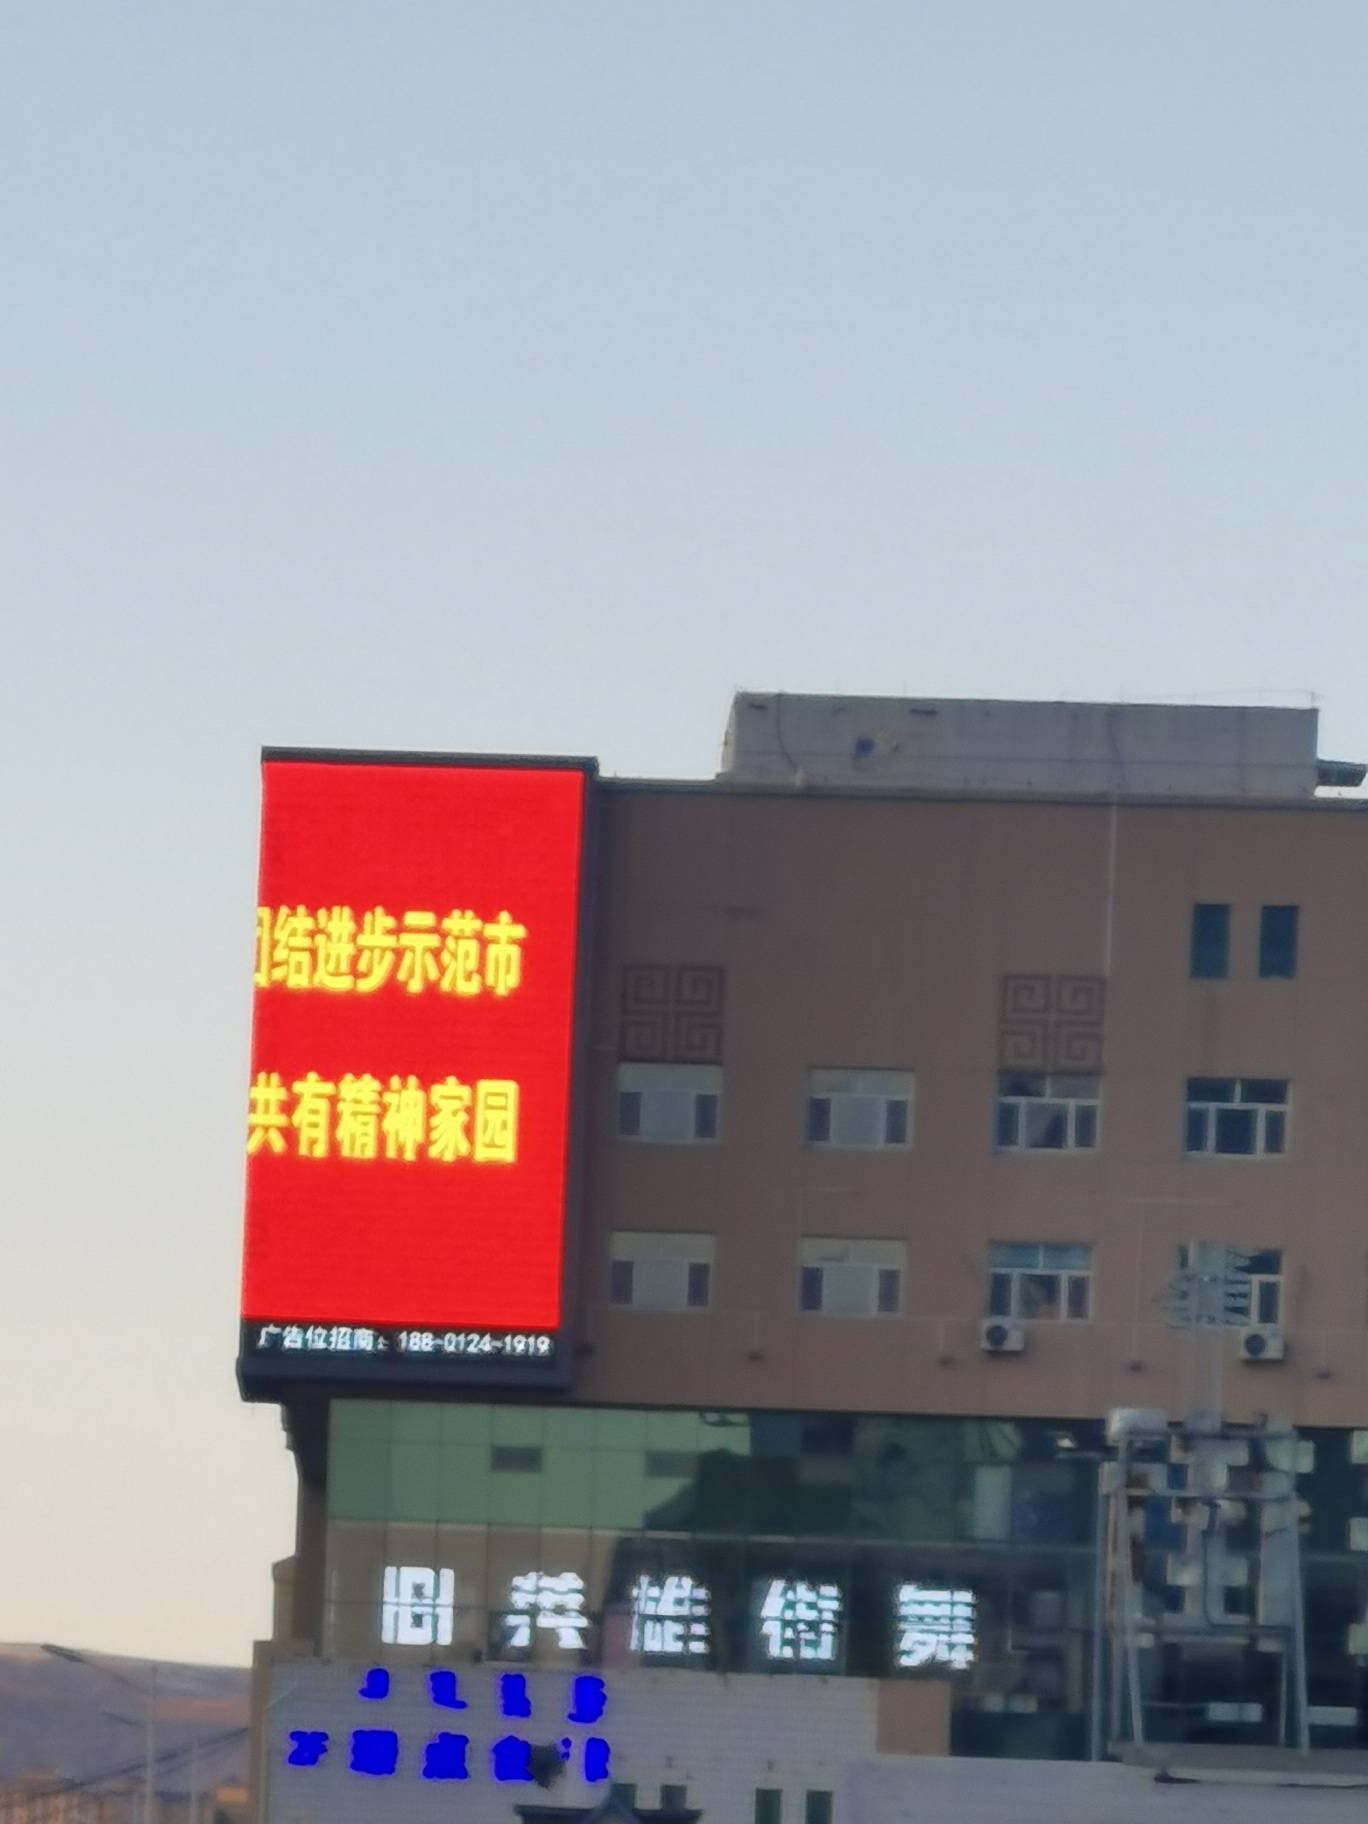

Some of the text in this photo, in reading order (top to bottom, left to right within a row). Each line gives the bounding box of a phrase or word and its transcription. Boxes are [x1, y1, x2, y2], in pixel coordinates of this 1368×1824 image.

[247, 1071, 519, 1163] 共有精神家园
